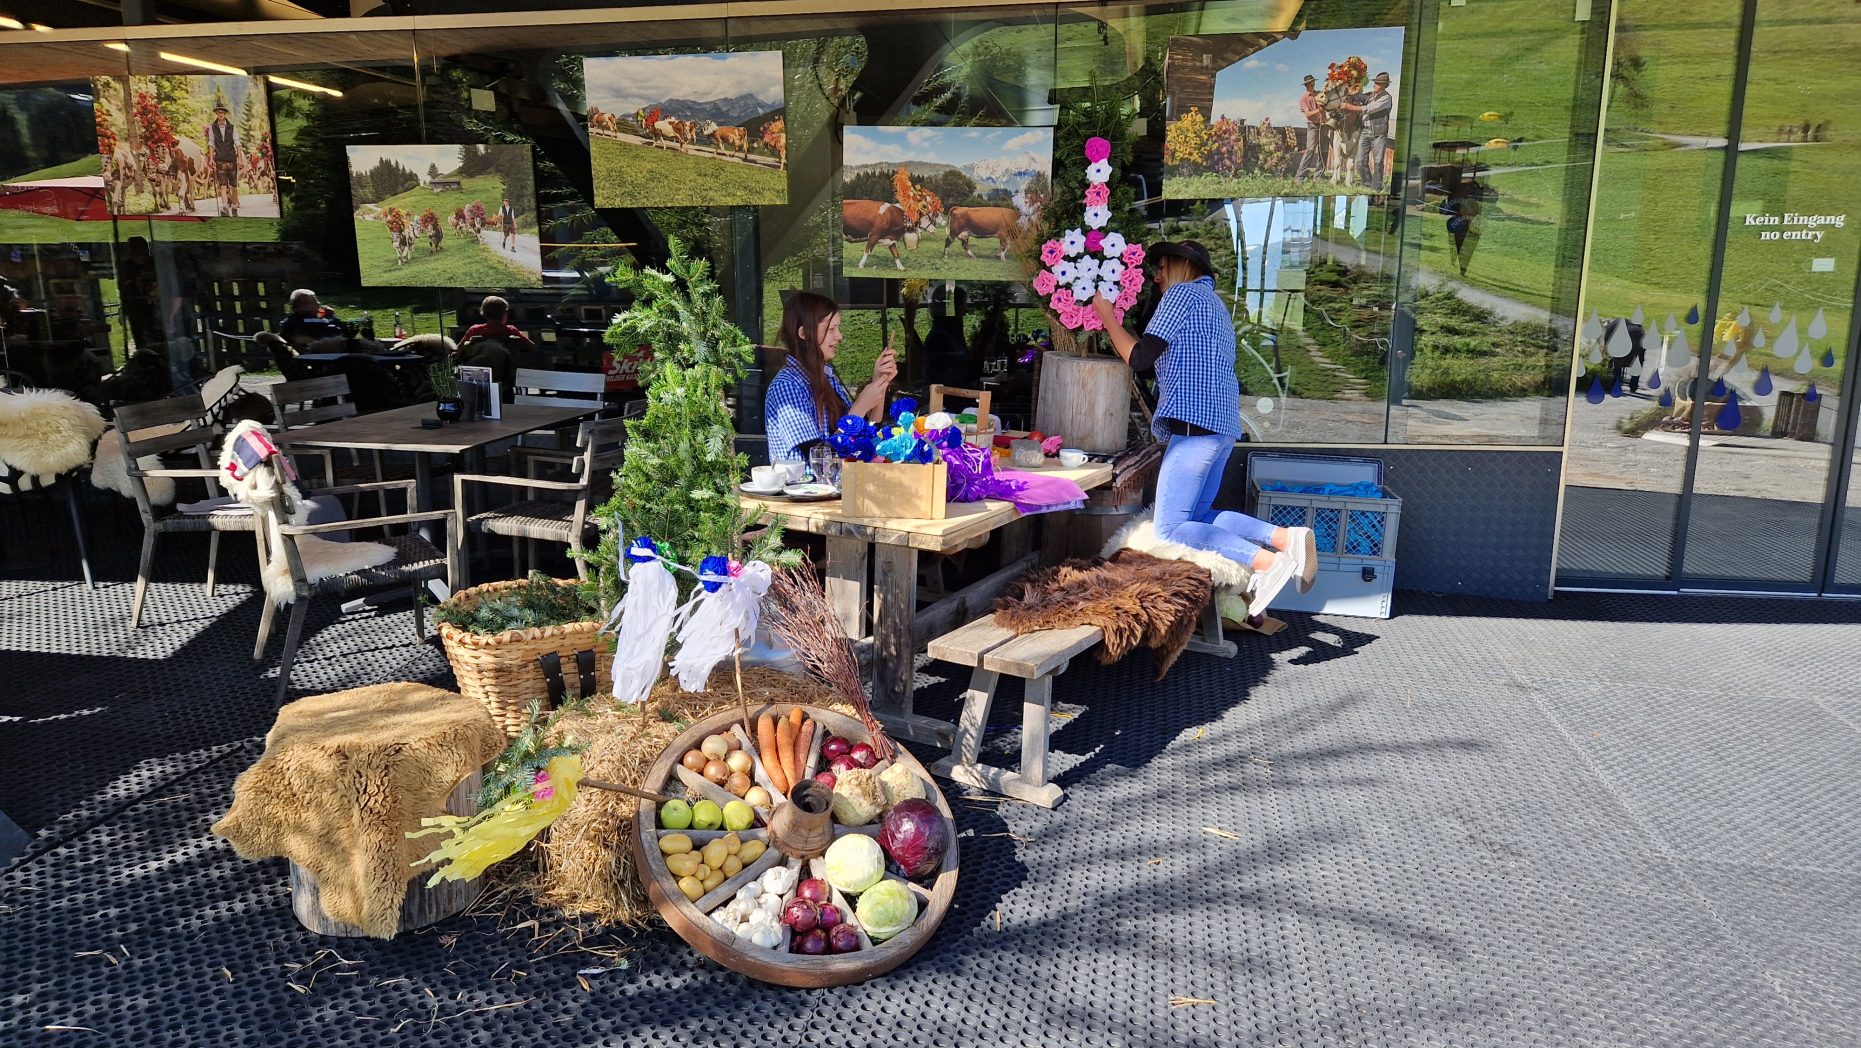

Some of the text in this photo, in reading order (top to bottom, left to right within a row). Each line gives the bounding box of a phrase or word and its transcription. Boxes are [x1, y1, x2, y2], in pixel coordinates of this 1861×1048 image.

[1744, 212, 1846, 228] Kein Eingang
[1760, 229, 1824, 243] no entry
